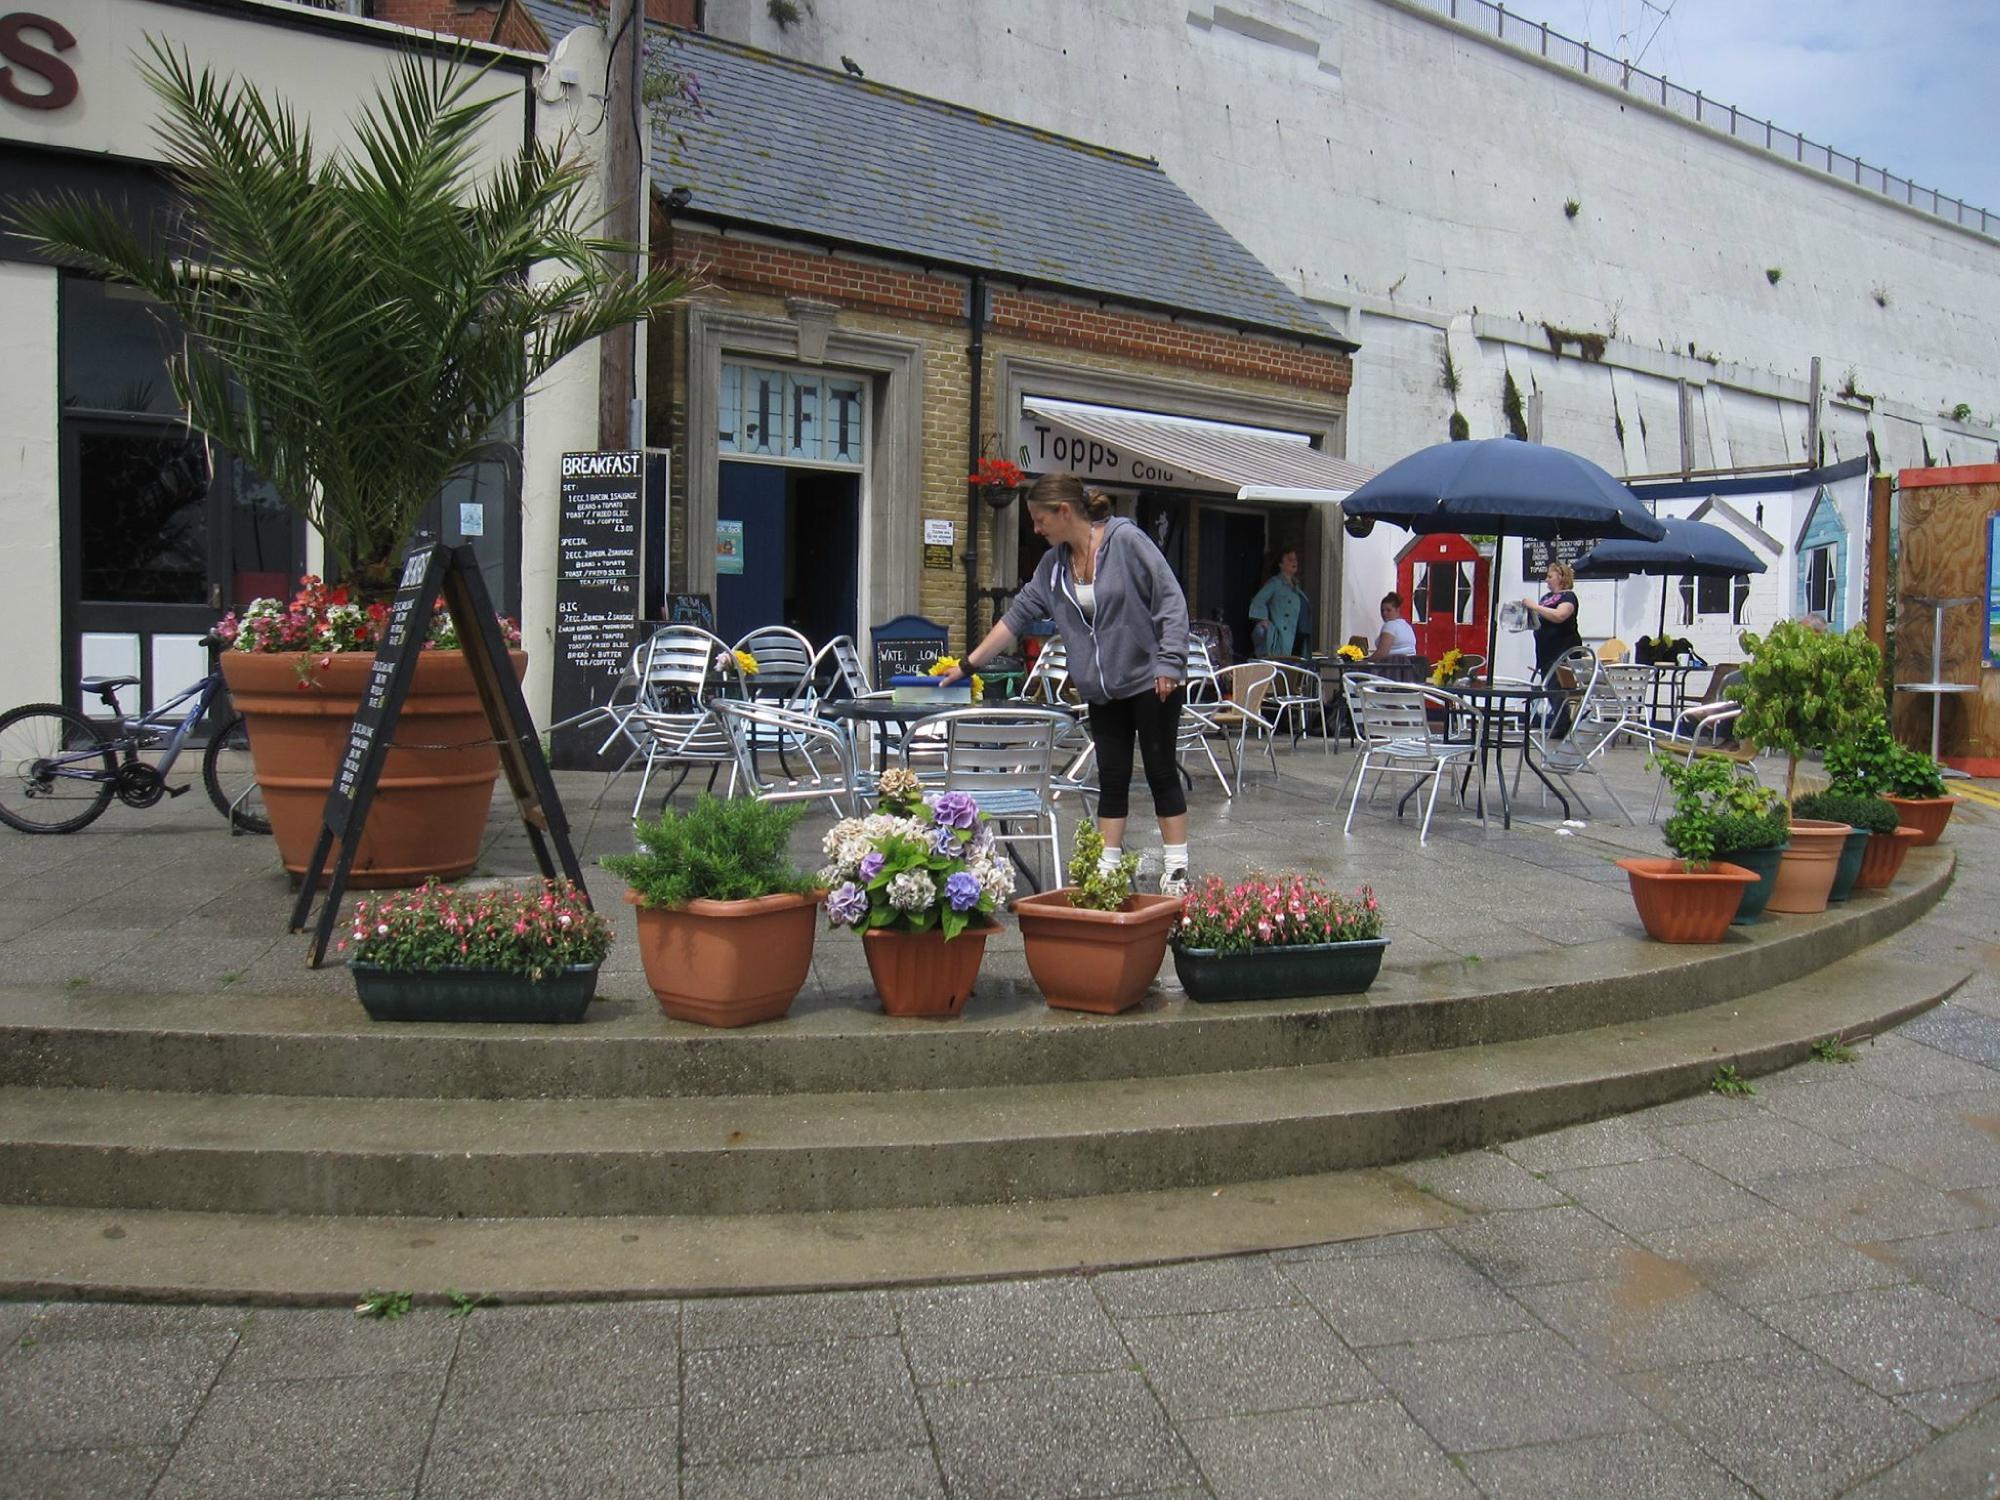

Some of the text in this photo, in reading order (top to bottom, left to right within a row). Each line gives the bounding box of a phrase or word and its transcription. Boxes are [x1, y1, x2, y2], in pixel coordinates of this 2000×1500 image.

[0, 12, 78, 109] S
[719, 378, 857, 453] IFT
[562, 455, 640, 475] BREAKFAST
[1035, 425, 1119, 473] Topps
[560, 537, 588, 546] SPECIAL
